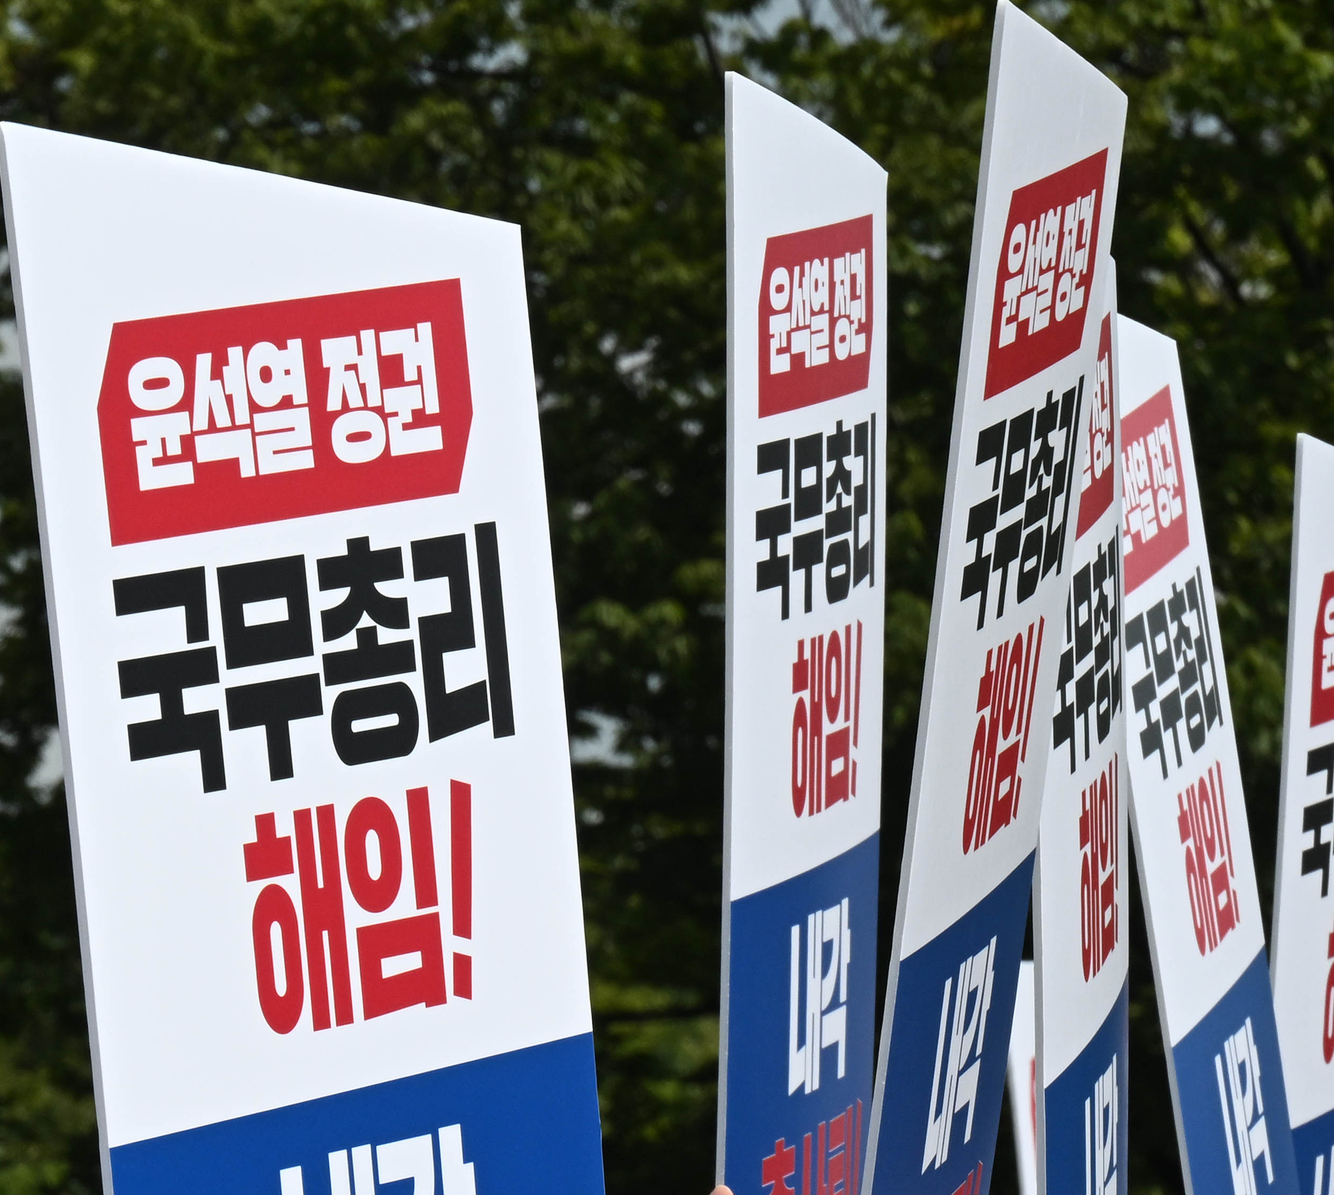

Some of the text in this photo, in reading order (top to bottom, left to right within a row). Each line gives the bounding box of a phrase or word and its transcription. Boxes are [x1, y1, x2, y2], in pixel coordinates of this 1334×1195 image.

[769, 247, 867, 374] 윤석열 정권
[998, 188, 1097, 348] 윤석열 정권
[127, 321, 444, 491] 윤석열 정권
[960, 374, 1085, 631] 국무총리
[755, 412, 876, 621] 국무총리
[112, 521, 515, 795] 국무총리
[791, 619, 863, 818] 해임!
[962, 615, 1045, 855] 해임!
[1053, 524, 1123, 775] 국무총리
[1125, 565, 1224, 781] 국무총리
[242, 778, 473, 1036] 해임!
[1079, 752, 1119, 983] 해임!
[1177, 759, 1241, 958] 해임!
[787, 897, 851, 1096] 내각
[922, 935, 997, 1175] 내각
